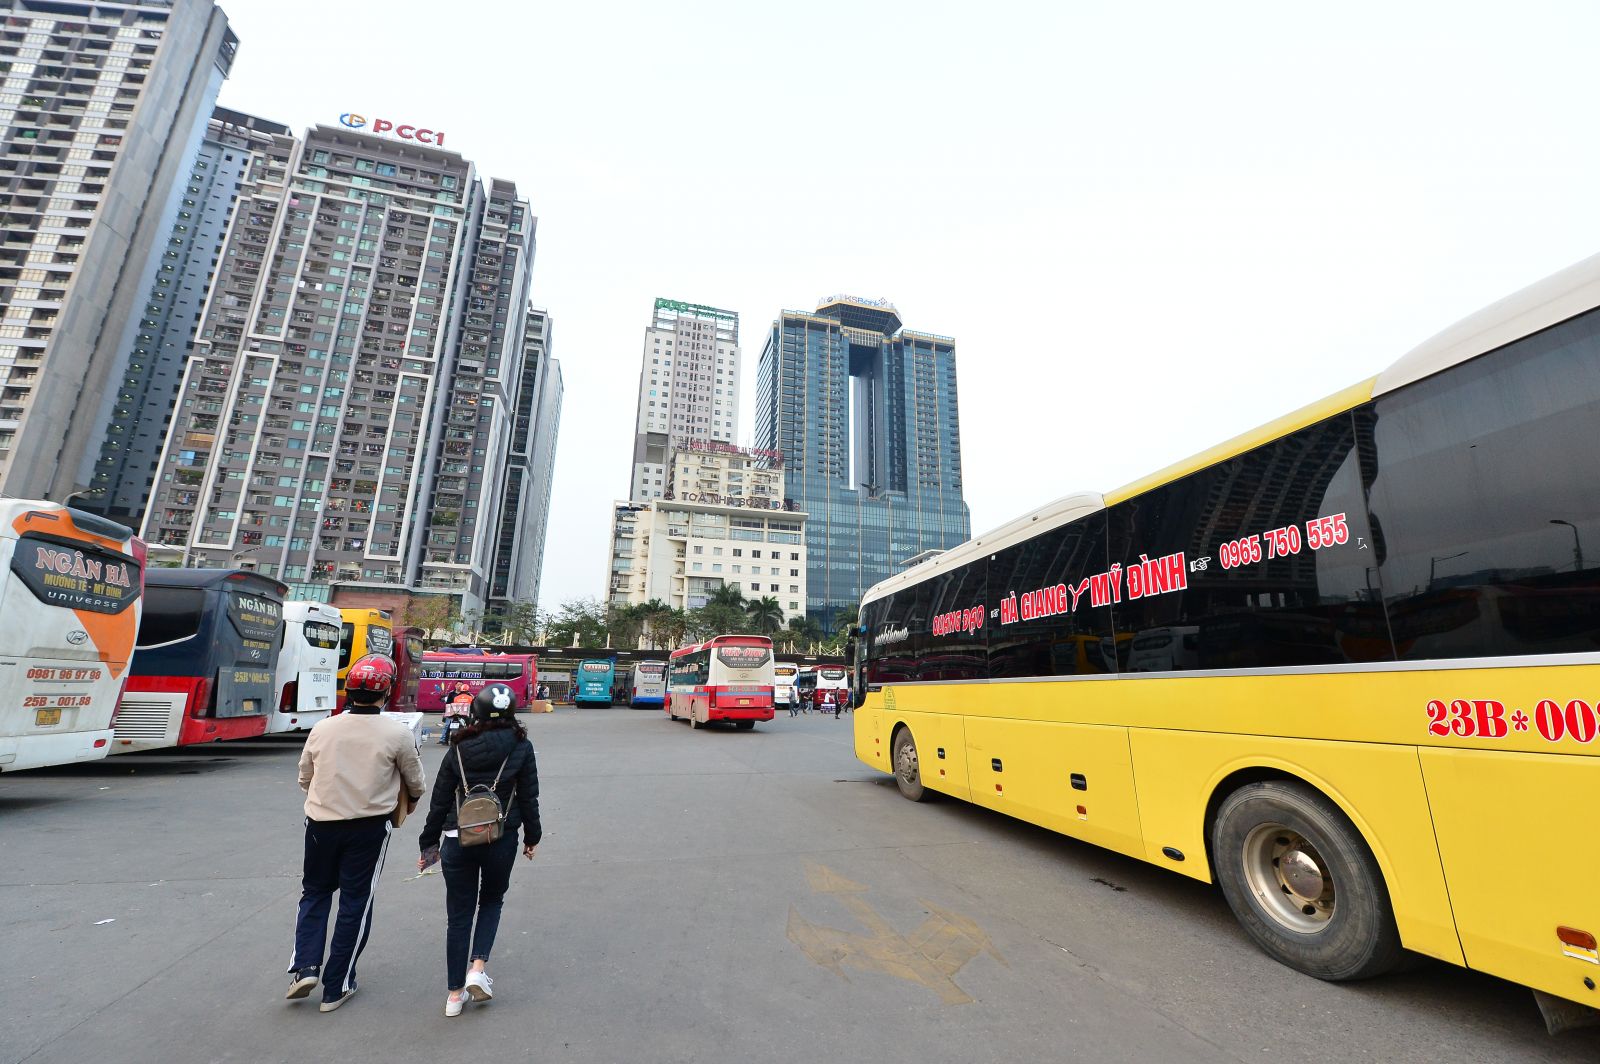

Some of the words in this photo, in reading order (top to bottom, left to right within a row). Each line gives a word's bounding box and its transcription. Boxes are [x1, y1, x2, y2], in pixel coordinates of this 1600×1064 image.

[373, 119, 445, 146] PCC1
[36, 547, 102, 581] NGÂN
[105, 563, 130, 587] HÀ
[962, 605, 985, 635] ĐẠO
[1000, 591, 1019, 625] HÀ
[1020, 583, 1067, 621] GIANG
[1090, 562, 1122, 608] MỸ
[1127, 552, 1187, 600] ĐÌNH
[1220, 534, 1262, 569] 0965
[1264, 525, 1301, 559] 750
[1306, 512, 1349, 550] 555
[239, 597, 266, 614] NGÂN
[267, 605, 278, 617] HÀ
[27, 668, 55, 680] 0981
[59, 670, 72, 680] 96
[75, 670, 88, 680] 97
[89, 670, 101, 680] 98
[23, 696, 48, 707] 25B
[57, 696, 91, 707] 001.88
[1426, 699, 1600, 743] 23B00
